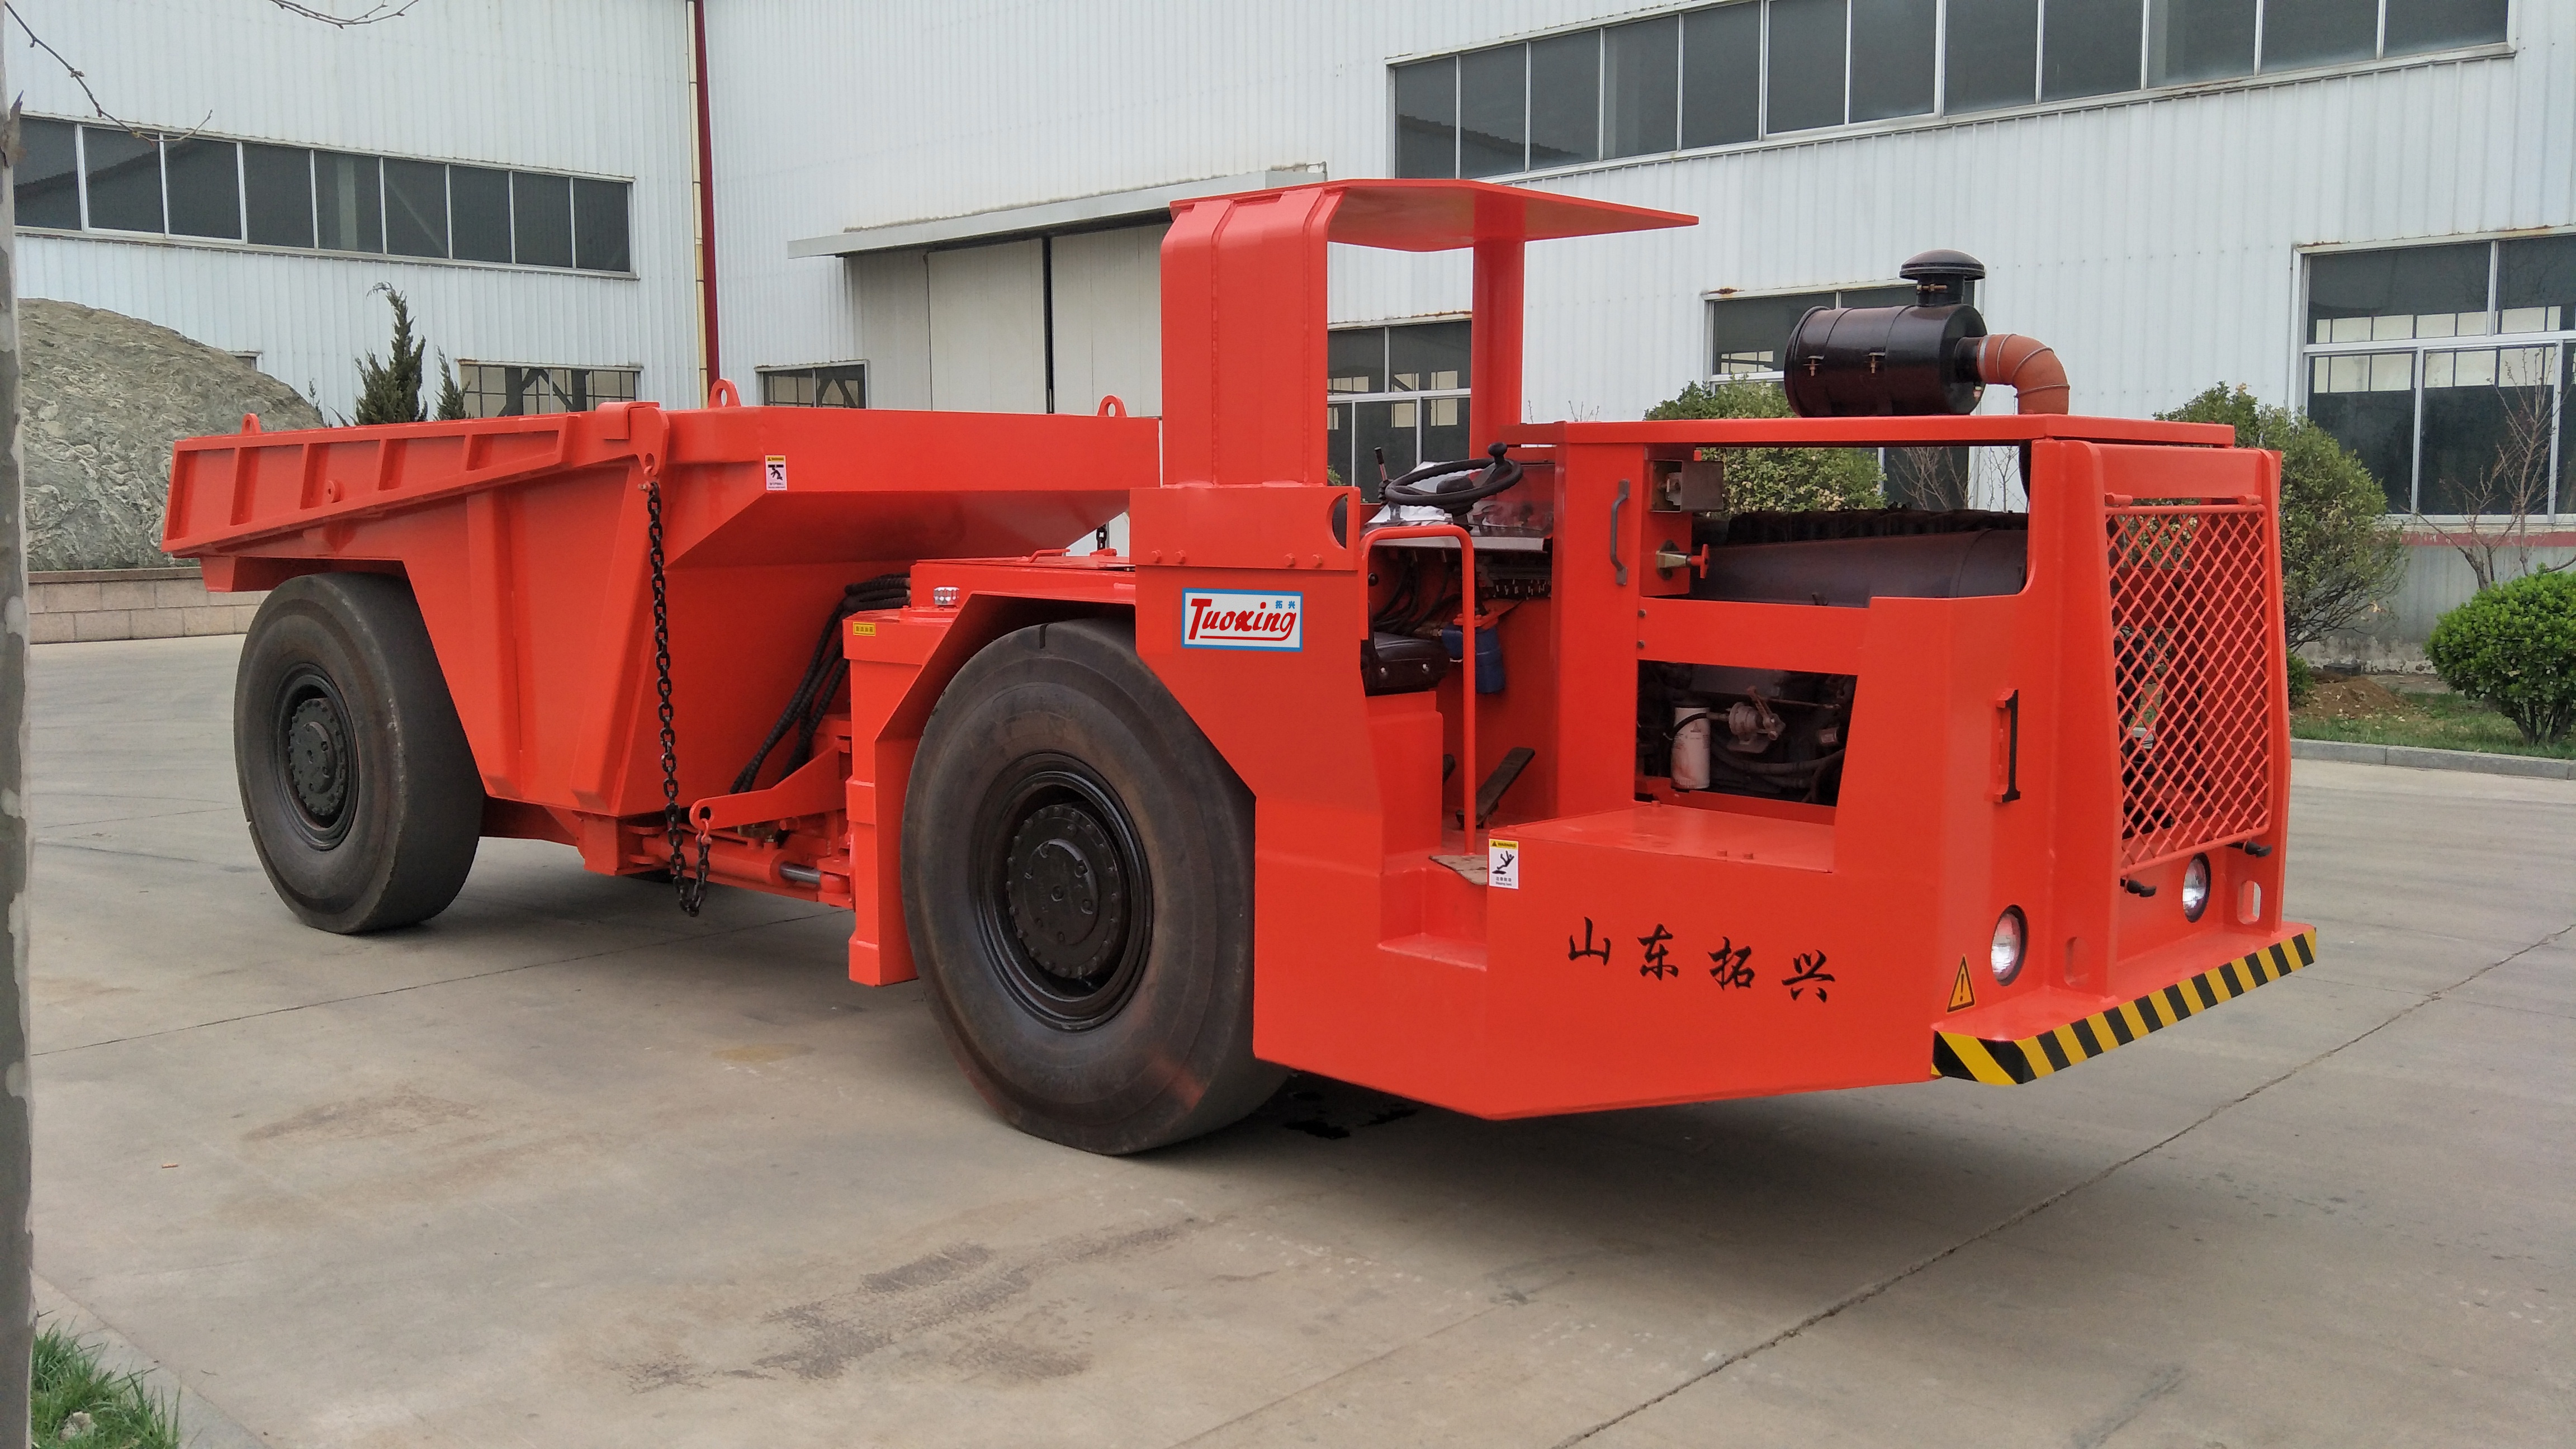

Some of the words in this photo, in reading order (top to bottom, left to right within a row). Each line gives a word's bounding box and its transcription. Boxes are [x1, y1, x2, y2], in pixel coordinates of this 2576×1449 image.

[1188, 598, 1297, 641] Tuoxing
[1275, 600, 1296, 609] 拓兴
[1568, 916, 1836, 1003] 山东拓兴
